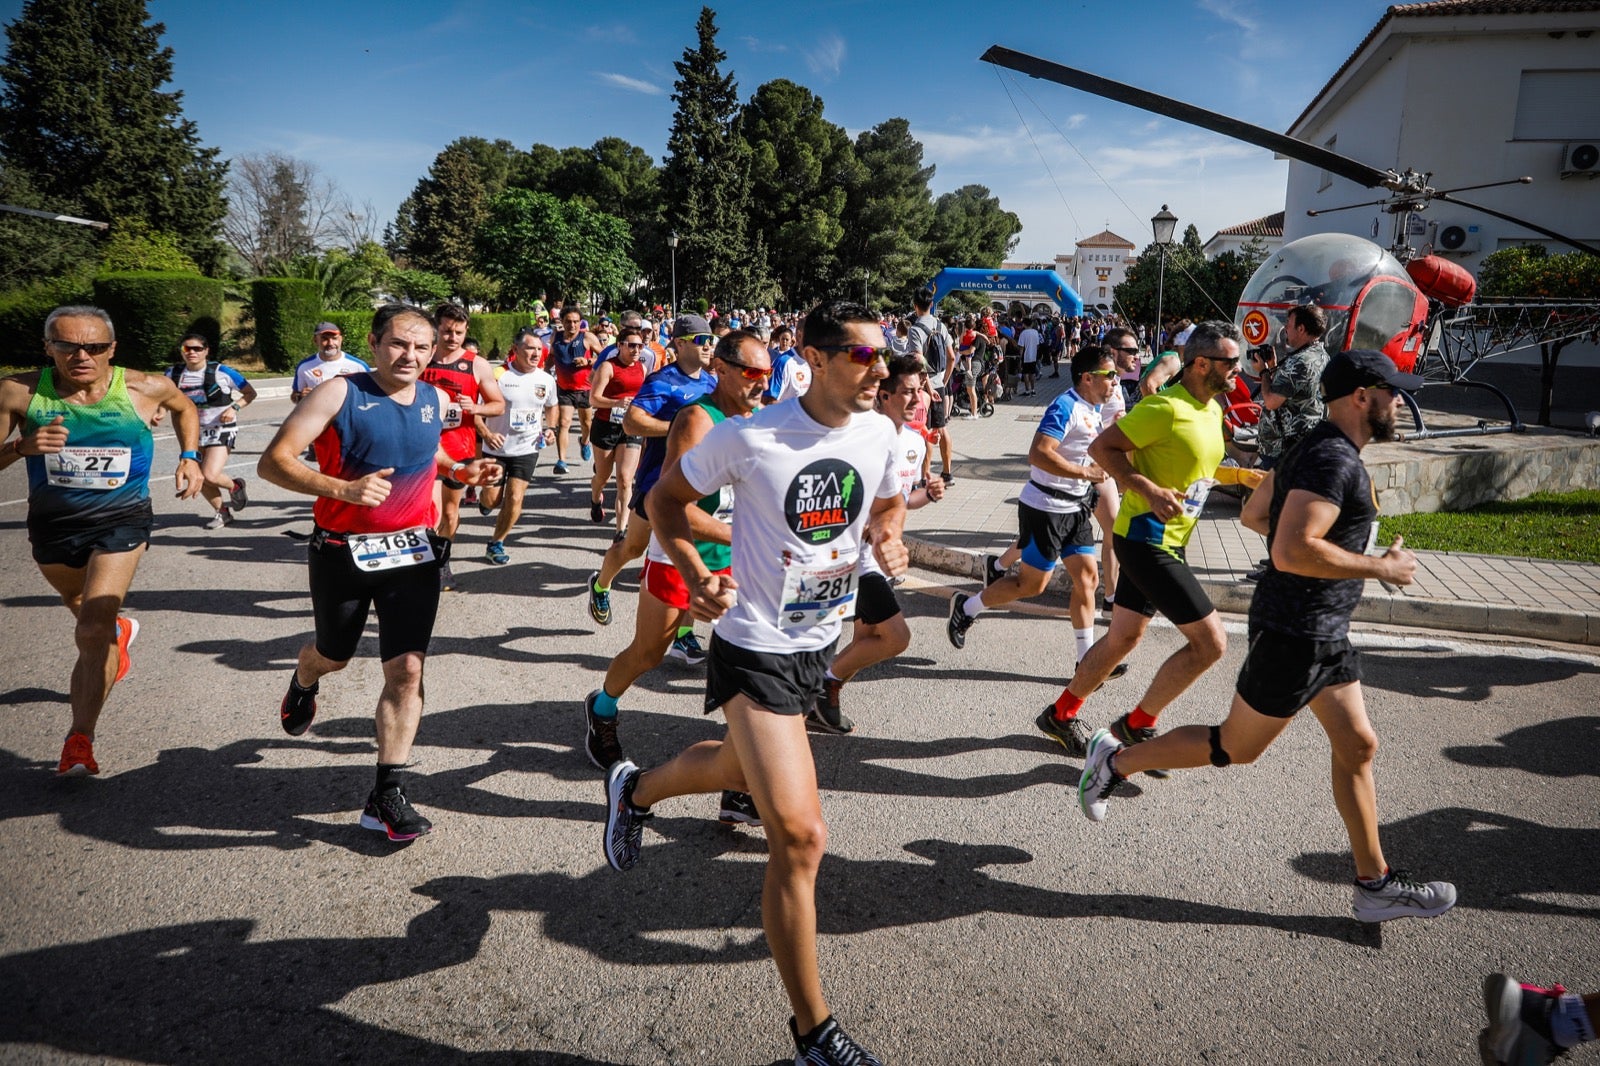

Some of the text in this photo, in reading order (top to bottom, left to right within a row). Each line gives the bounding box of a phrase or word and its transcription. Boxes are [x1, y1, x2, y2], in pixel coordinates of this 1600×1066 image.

[960, 281, 993, 289] EJÉRCITO
[525, 412, 536, 422] 68
[84, 456, 114, 471] 27
[796, 495, 842, 514] DOLAR
[800, 509, 846, 529] TRAIL
[379, 532, 420, 550] 168
[811, 529, 831, 541] 2021
[814, 573, 852, 601] 281
